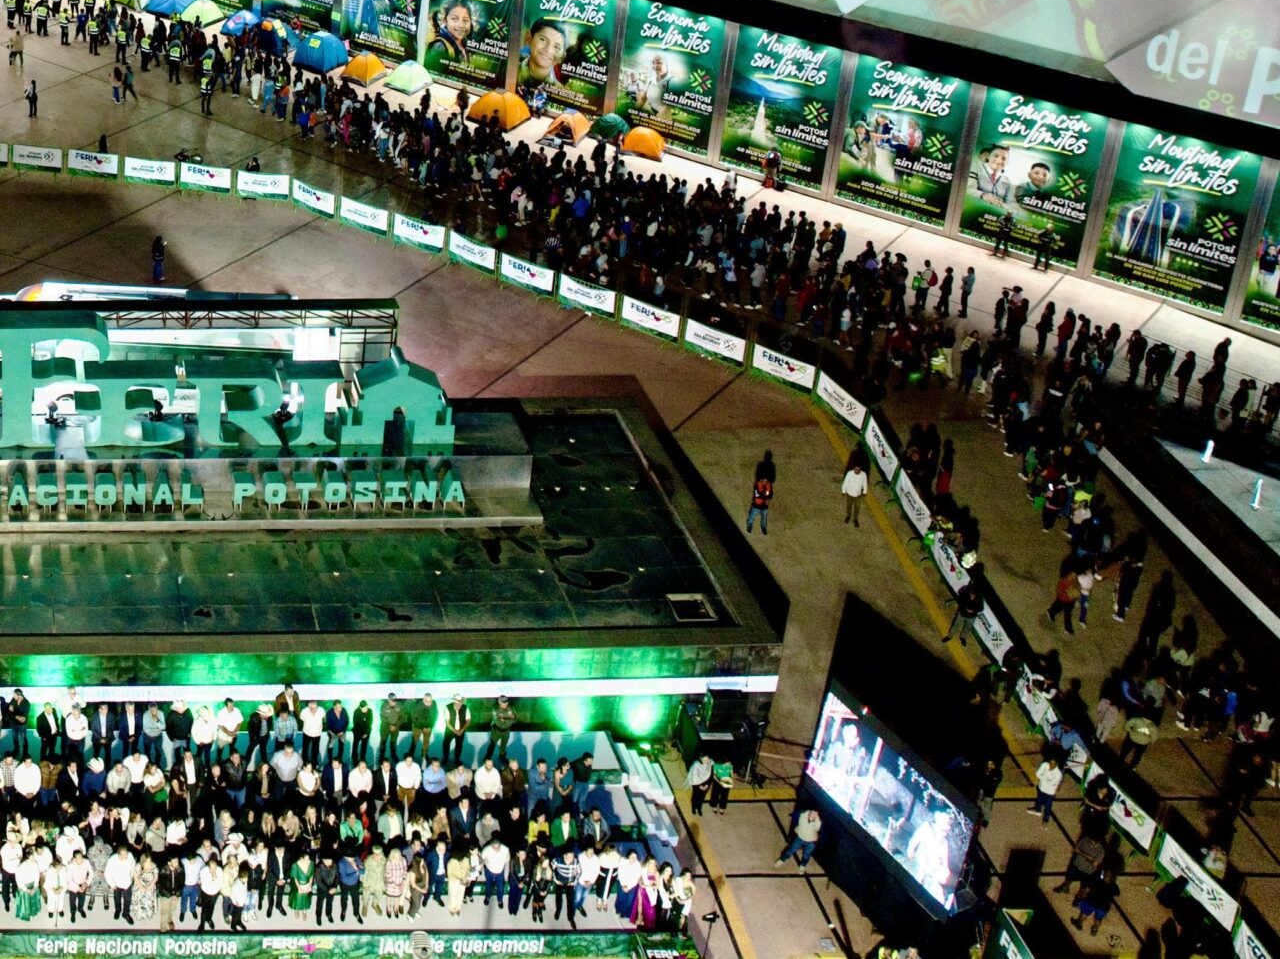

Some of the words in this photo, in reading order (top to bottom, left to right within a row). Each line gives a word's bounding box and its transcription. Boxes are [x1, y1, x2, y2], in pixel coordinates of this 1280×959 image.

[648, 2, 711, 32] Economía
[641, 23, 666, 39] sin
[466, 39, 479, 49] sin
[757, 32, 828, 68] Movilidad
[751, 52, 778, 70] sin
[1146, 27, 1222, 86] del
[561, 63, 574, 73] sin
[581, 62, 606, 73] POTOSÍ
[873, 61, 959, 99] Seguridad
[663, 92, 678, 103] sin
[679, 94, 713, 113] límites
[685, 91, 712, 102] POTOSÍ
[868, 82, 898, 99] sin
[893, 84, 951, 117] límites
[1005, 96, 1091, 134] Educación
[775, 125, 791, 135] sin
[792, 127, 829, 147] límites
[799, 124, 828, 136] POTOSÍ
[998, 116, 1027, 135] sin
[1024, 119, 1089, 155] límites
[920, 156, 953, 169] POTOSÍ
[1148, 133, 1241, 176] Movilidad
[894, 157, 912, 168] sin
[913, 159, 953, 181] límites
[1139, 155, 1173, 175] sin
[1169, 158, 1239, 194] límites
[875, 184, 898, 195] MEJOR
[899, 191, 926, 203] ESTADO
[1051, 195, 1087, 209] POTOSÍ
[1022, 196, 1042, 209] sin
[1043, 199, 1087, 220] límites
[1166, 238, 1187, 251] sin
[1188, 241, 1237, 265] límites
[1198, 238, 1236, 253] POTOSÍ
[233, 481, 466, 508] POTOSINA
[36, 938, 78, 954] Feria
[86, 937, 157, 955] Nacional
[165, 937, 237, 955] Potosina
[452, 937, 545, 957] queremos!
